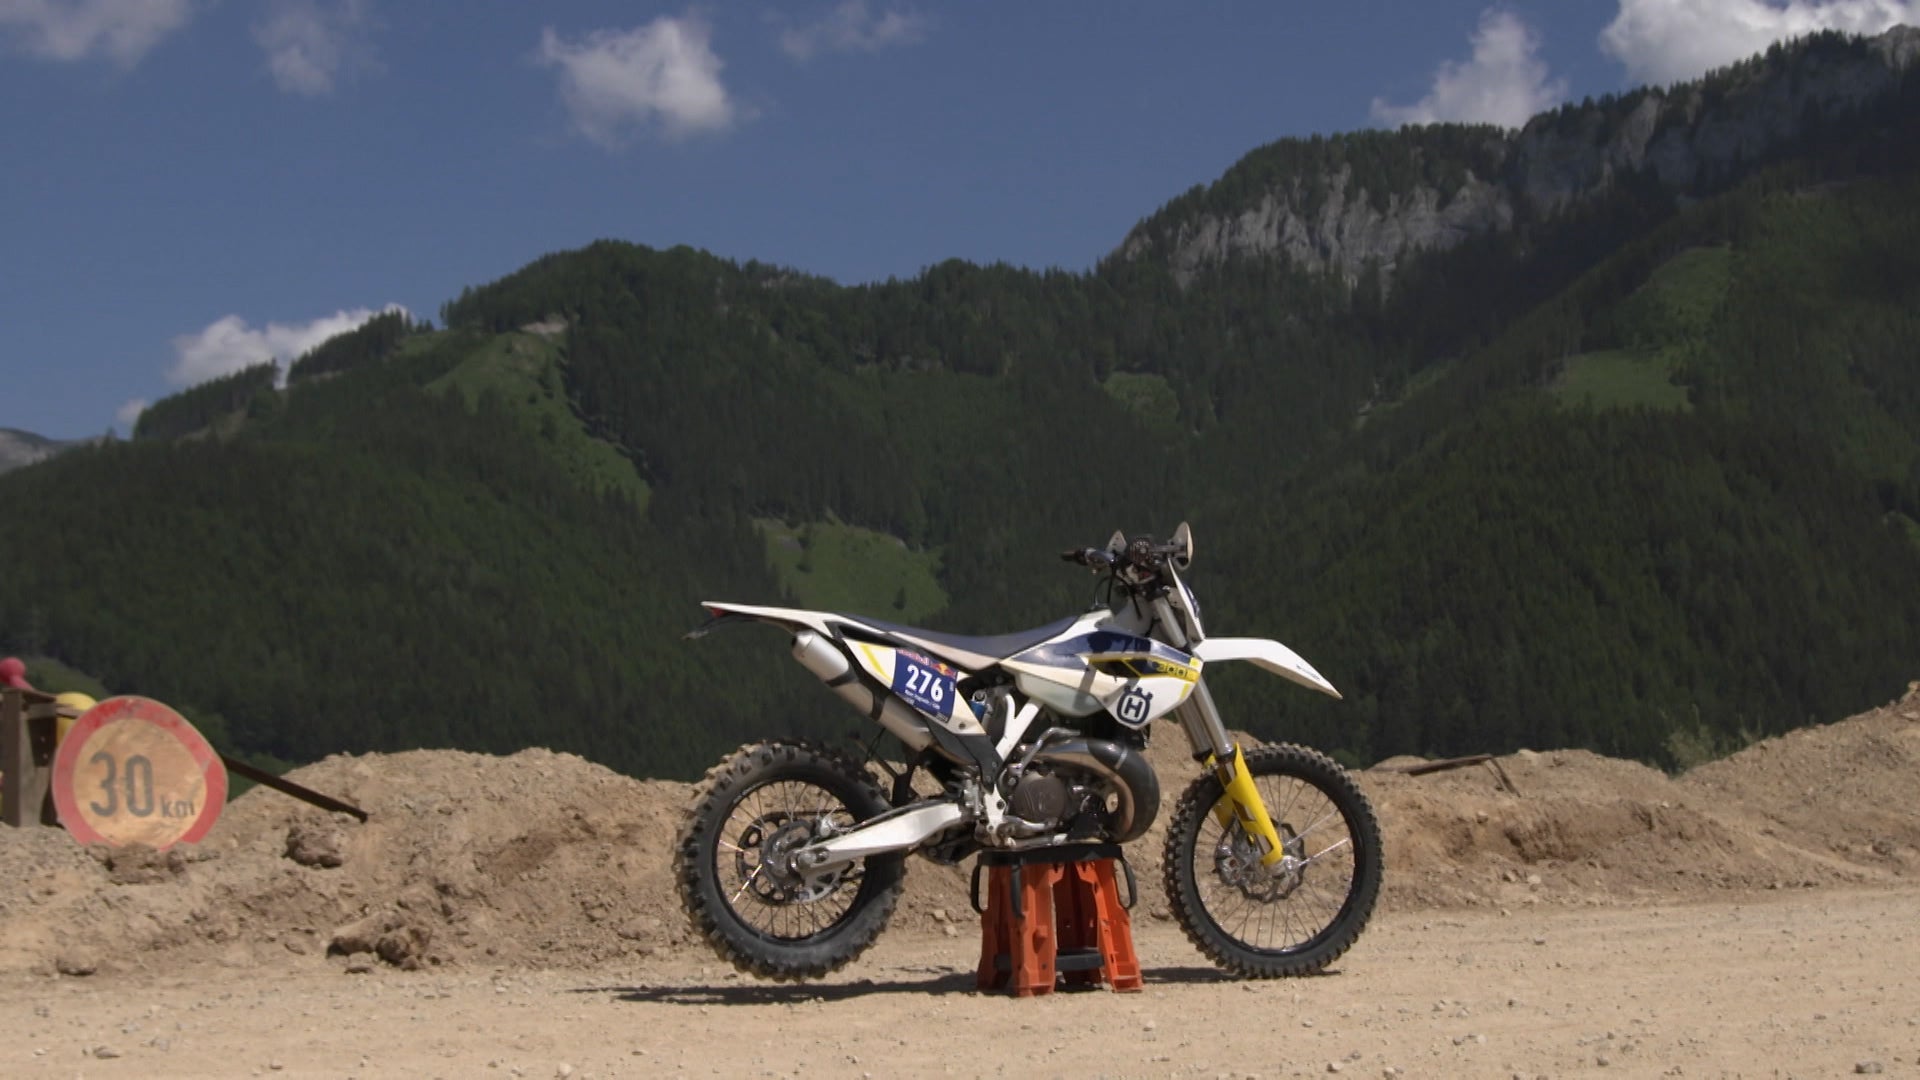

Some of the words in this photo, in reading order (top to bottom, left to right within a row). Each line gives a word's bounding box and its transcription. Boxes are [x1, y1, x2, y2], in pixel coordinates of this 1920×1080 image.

[905, 664, 943, 702] 276
[90, 751, 153, 818] 30
[160, 795, 195, 818] km
